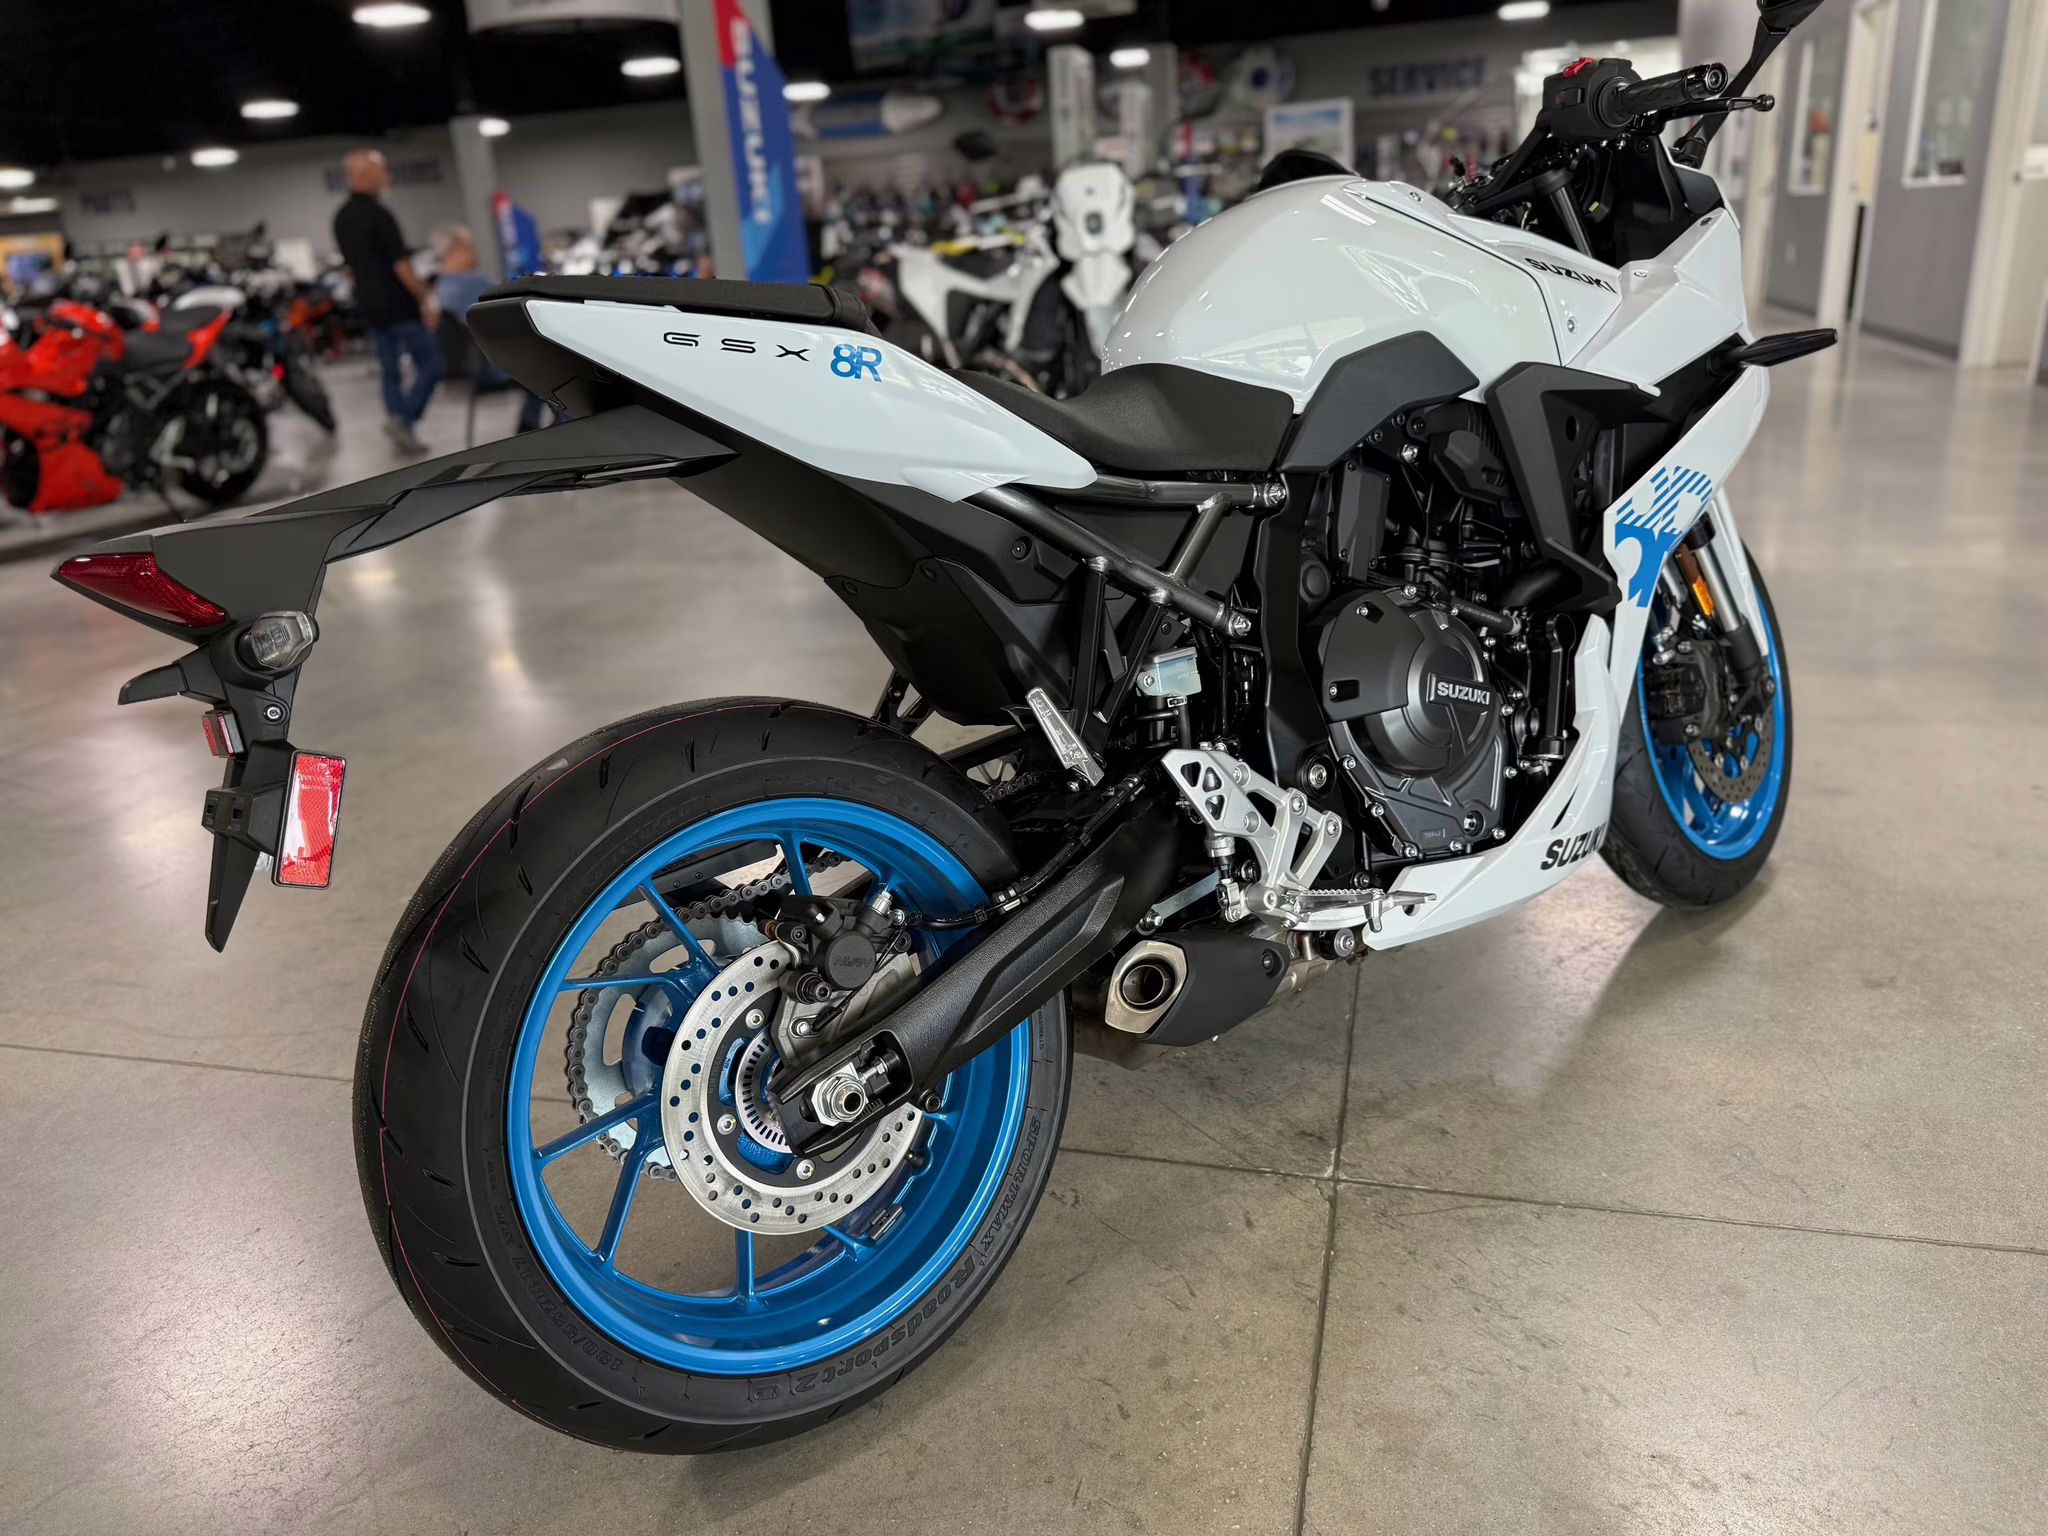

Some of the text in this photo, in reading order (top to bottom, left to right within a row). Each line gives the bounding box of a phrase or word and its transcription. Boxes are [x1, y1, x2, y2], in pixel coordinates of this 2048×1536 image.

[1524, 257, 1618, 295] SUZUKI
[830, 343, 884, 384] 8R
[1436, 681, 1491, 706] SUZUKI
[1540, 821, 1607, 871] SUZUKI
[979, 1115, 1042, 1253] SPORTMAX
